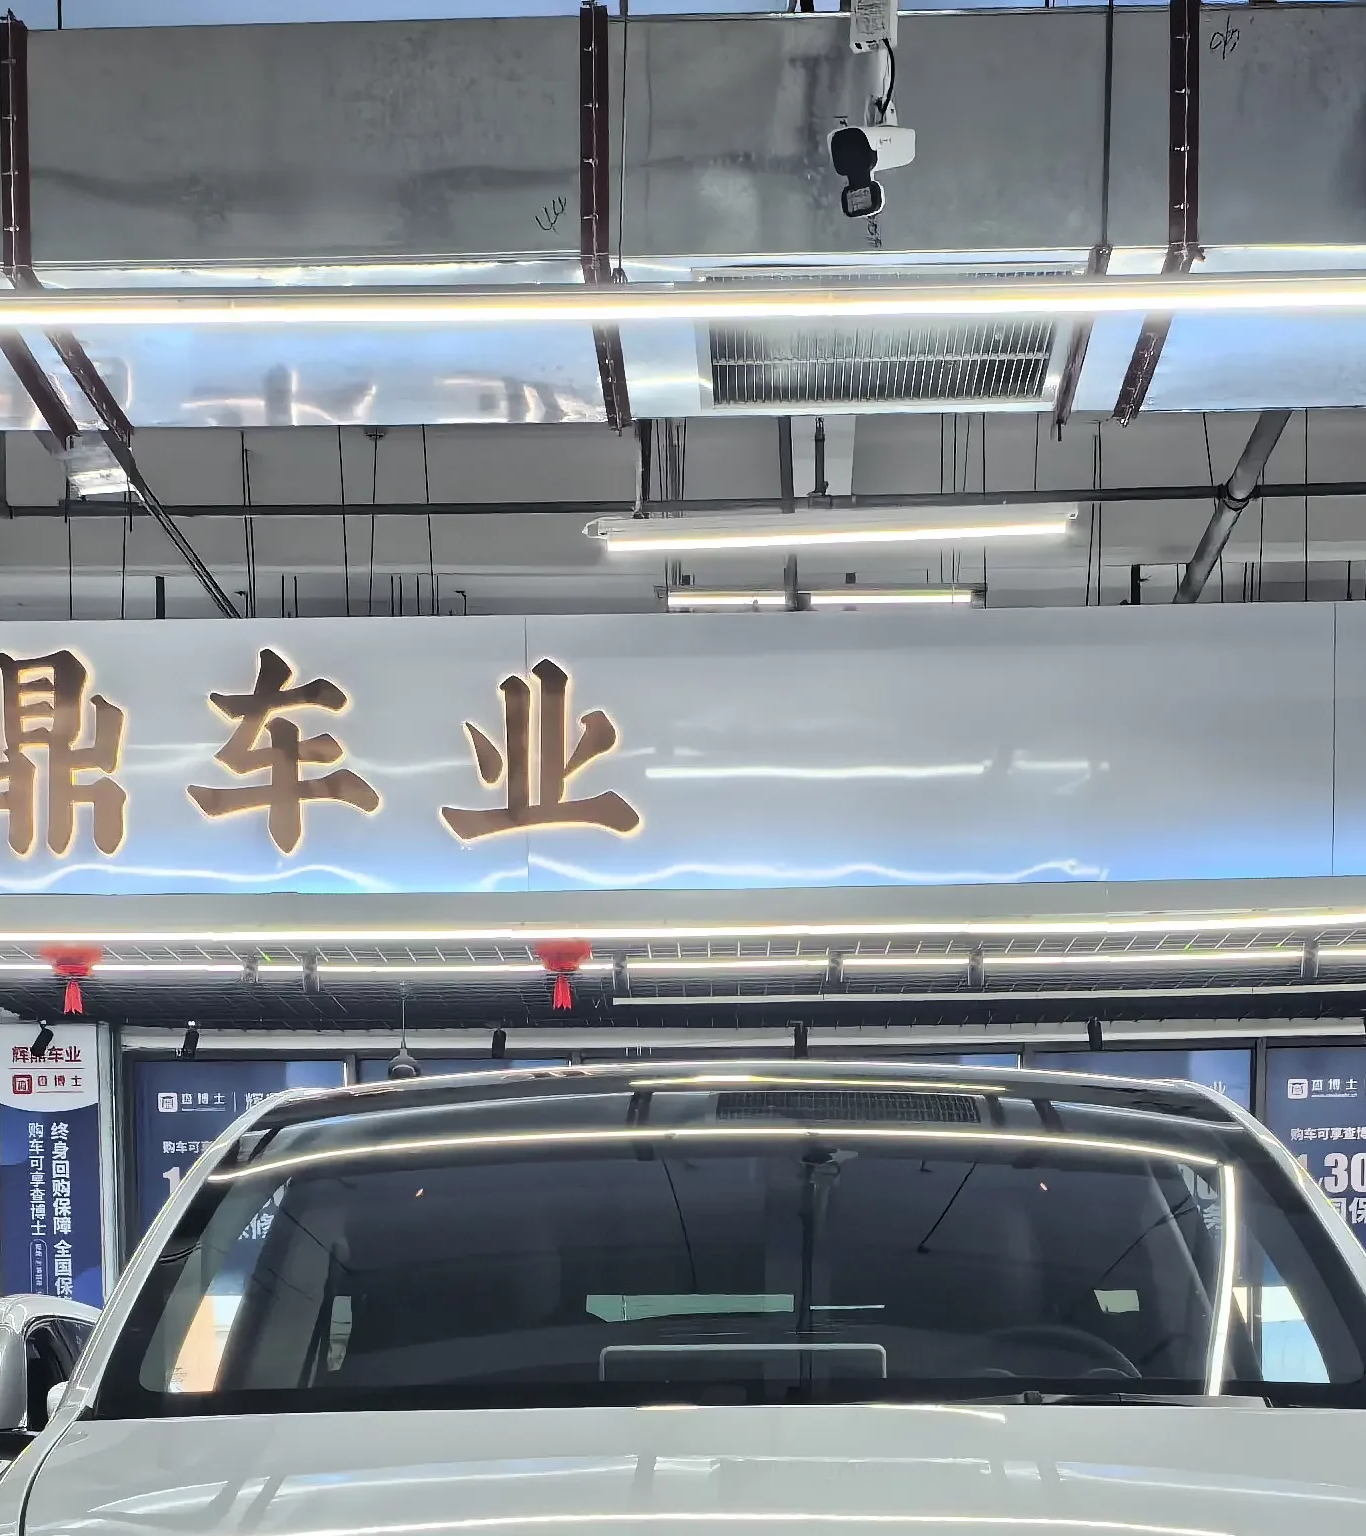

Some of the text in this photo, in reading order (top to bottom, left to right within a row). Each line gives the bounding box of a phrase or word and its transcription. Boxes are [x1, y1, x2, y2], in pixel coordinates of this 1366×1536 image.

[28, 1122, 47, 1236] 购车可享查博士
[50, 1121, 73, 1300] 终身回购保障 全国保
